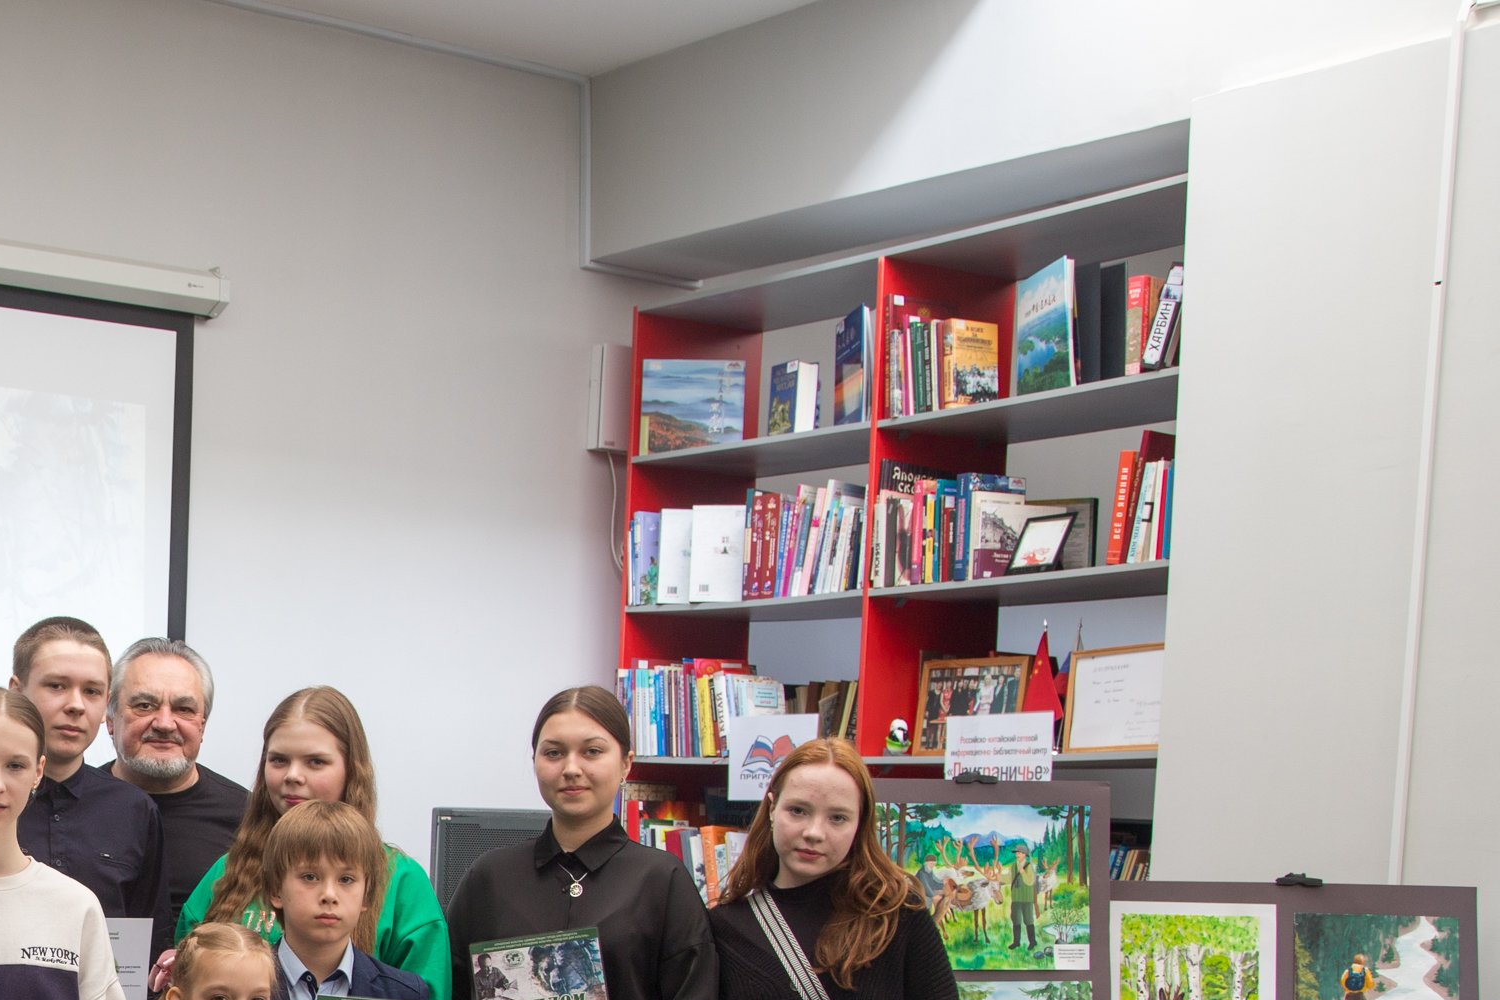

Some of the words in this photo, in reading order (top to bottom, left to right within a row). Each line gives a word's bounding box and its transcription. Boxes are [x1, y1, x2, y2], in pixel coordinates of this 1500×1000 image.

[1148, 302, 1173, 352] ХАРБИН
[1117, 467, 1129, 507] ЯПОНИИ
[21, 946, 48, 959] NEW
[49, 948, 79, 966] YORK
